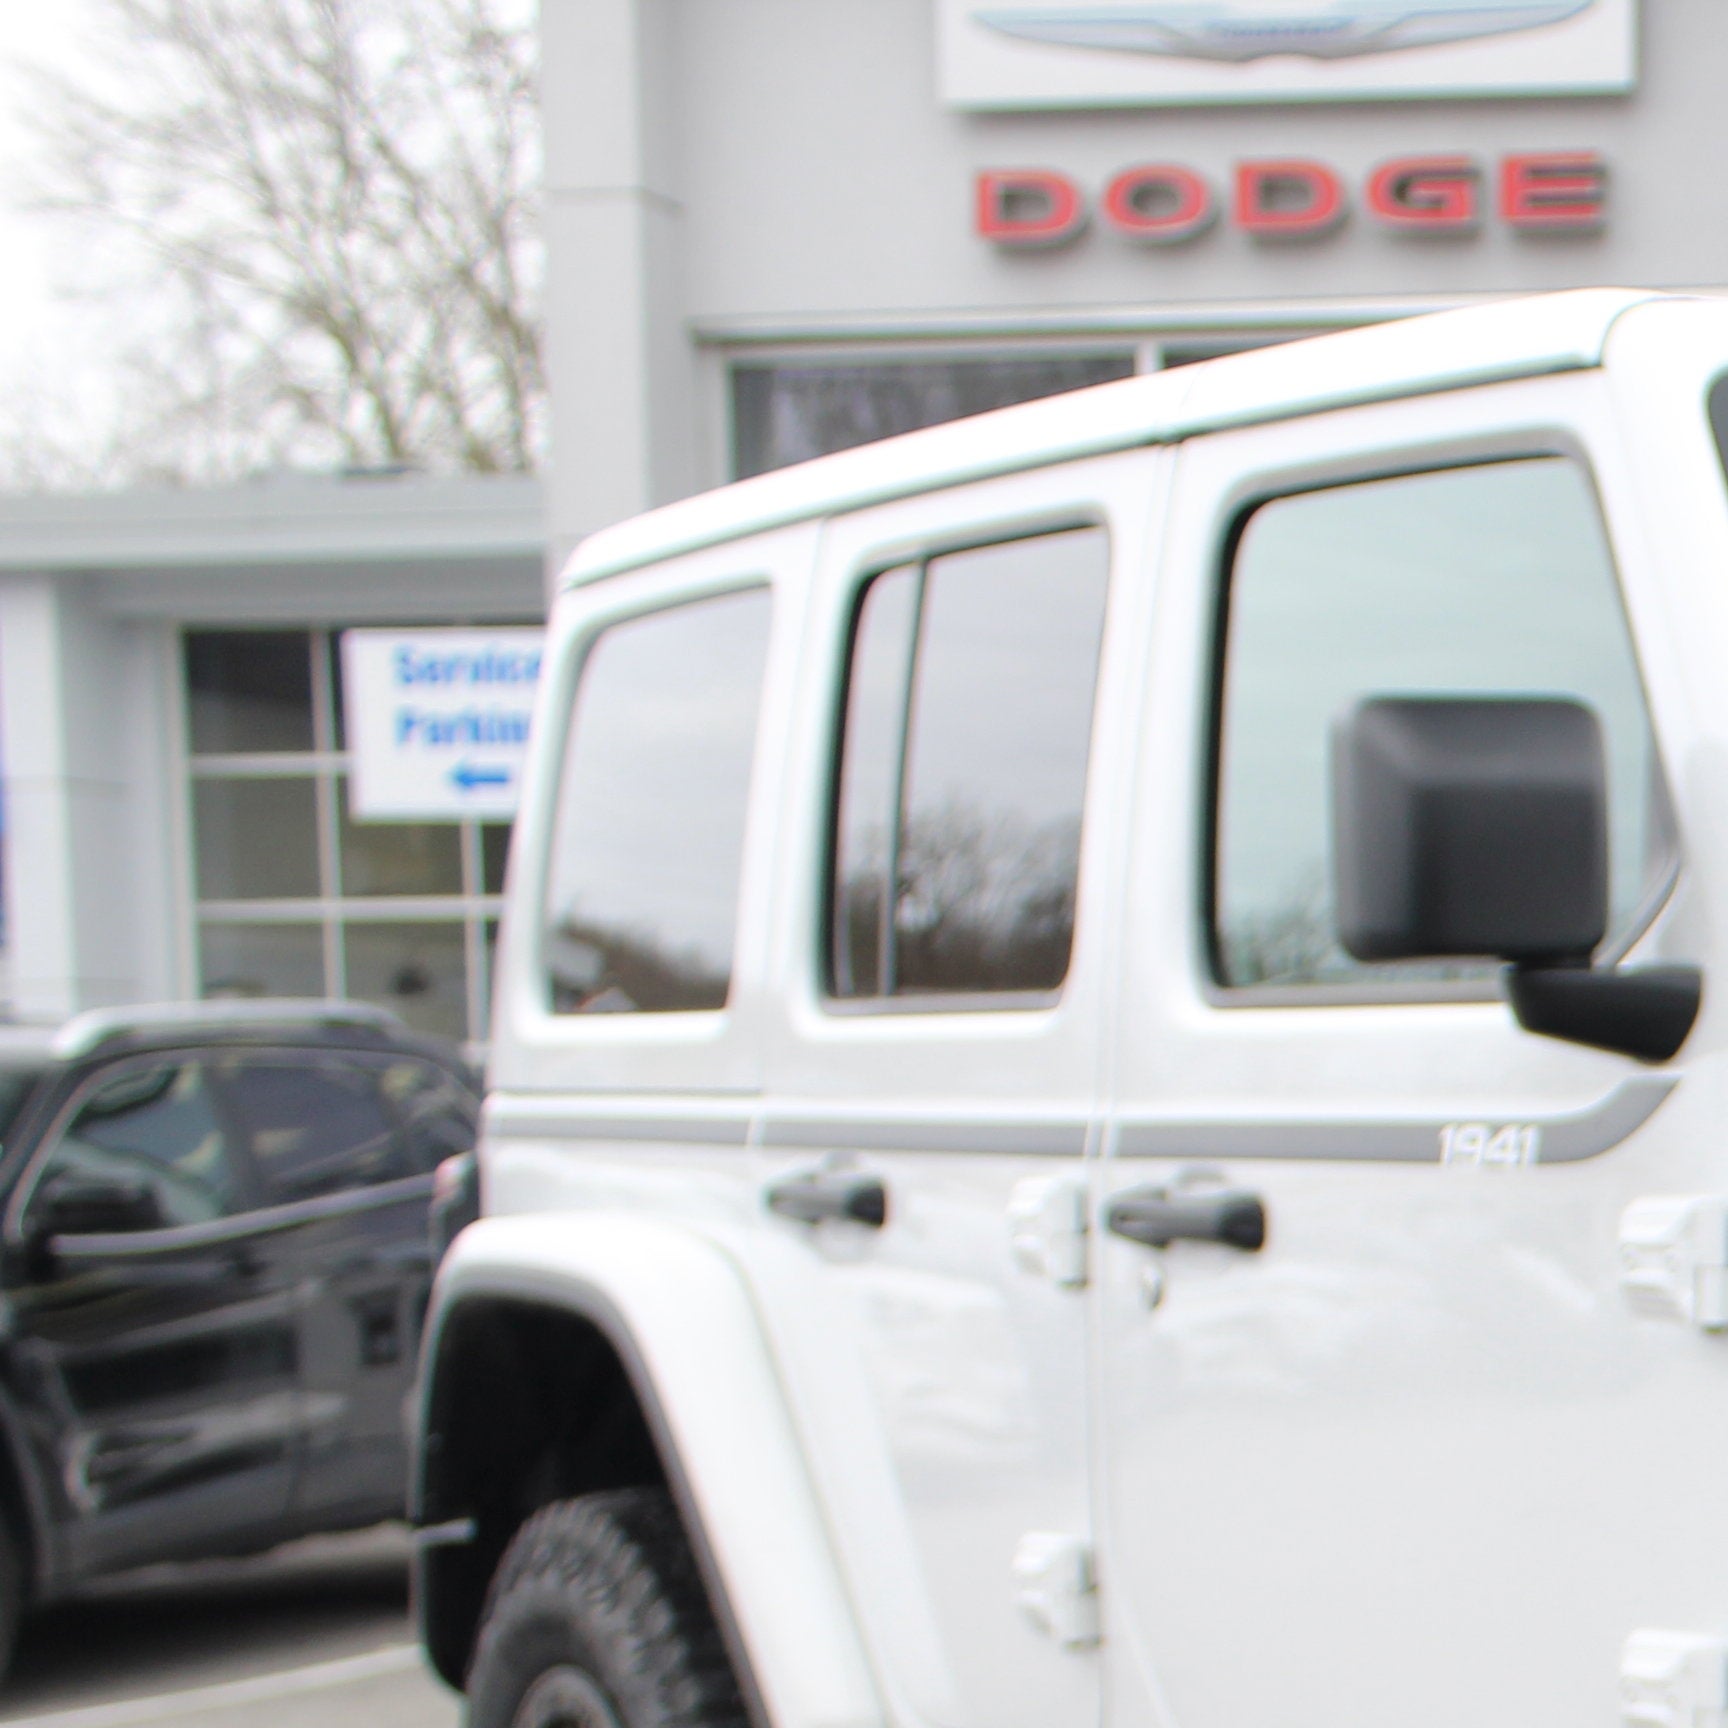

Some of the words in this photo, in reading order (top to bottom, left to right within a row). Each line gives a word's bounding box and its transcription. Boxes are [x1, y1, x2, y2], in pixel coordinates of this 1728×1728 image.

[973, 150, 1607, 243] DODGE
[394, 704, 530, 746] Parkin
[1438, 1122, 1540, 1168] 1941
